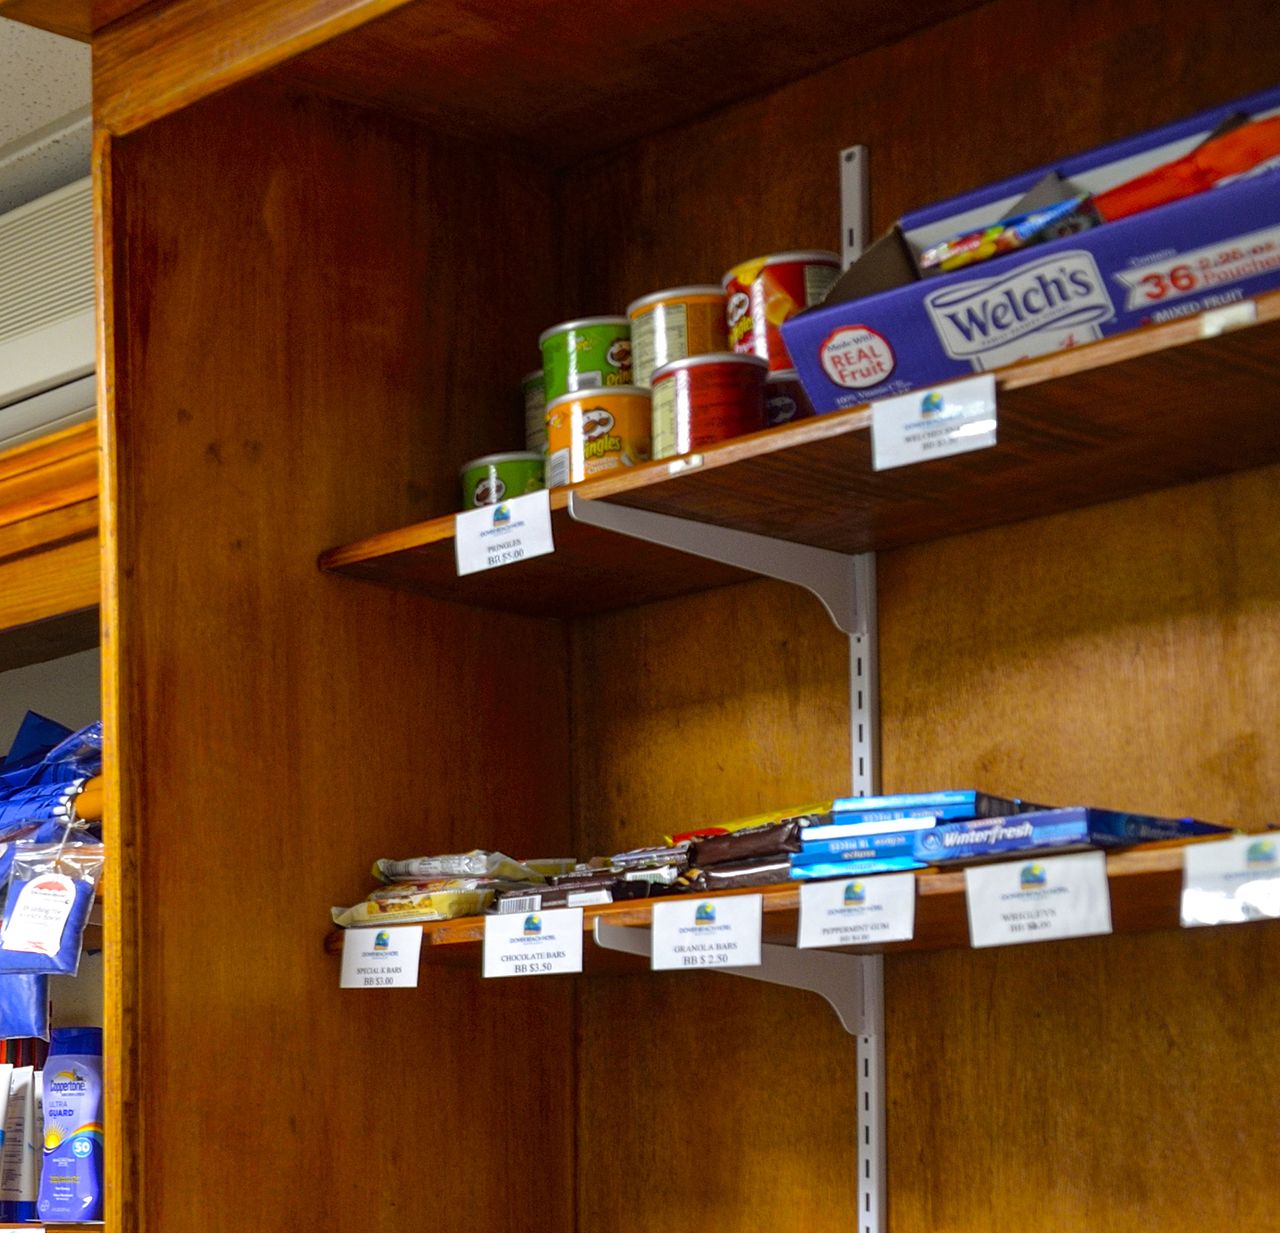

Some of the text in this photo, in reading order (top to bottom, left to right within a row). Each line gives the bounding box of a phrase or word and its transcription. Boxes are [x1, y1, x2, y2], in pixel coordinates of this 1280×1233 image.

[1140, 264, 1197, 300] 36
[946, 266, 1094, 342] Welch's
[1154, 288, 1245, 323] MIXED FRUIT
[831, 345, 884, 370] REAL
[838, 361, 887, 385] Fruit
[584, 435, 621, 459] ingles
[487, 539, 522, 553] PRINGLES
[943, 822, 1034, 849] Winterfresh
[821, 924, 870, 936] PEPPERMINT
[673, 941, 738, 954] GRANOLA BARS
[500, 950, 566, 962] CHOCOLATE BARS
[683, 955, 698, 966] BB
[708, 954, 729, 965] 2.50
[356, 966, 402, 975] SPECIAL K BARS
[514, 962, 552, 974] BB $3.50
[364, 977, 394, 986] BB $3.00
[50, 1079, 87, 1093] Coppertone
[48, 1101, 68, 1109] ULTRA
[48, 1109, 74, 1117] GUARD
[74, 1142, 90, 1152] 50
